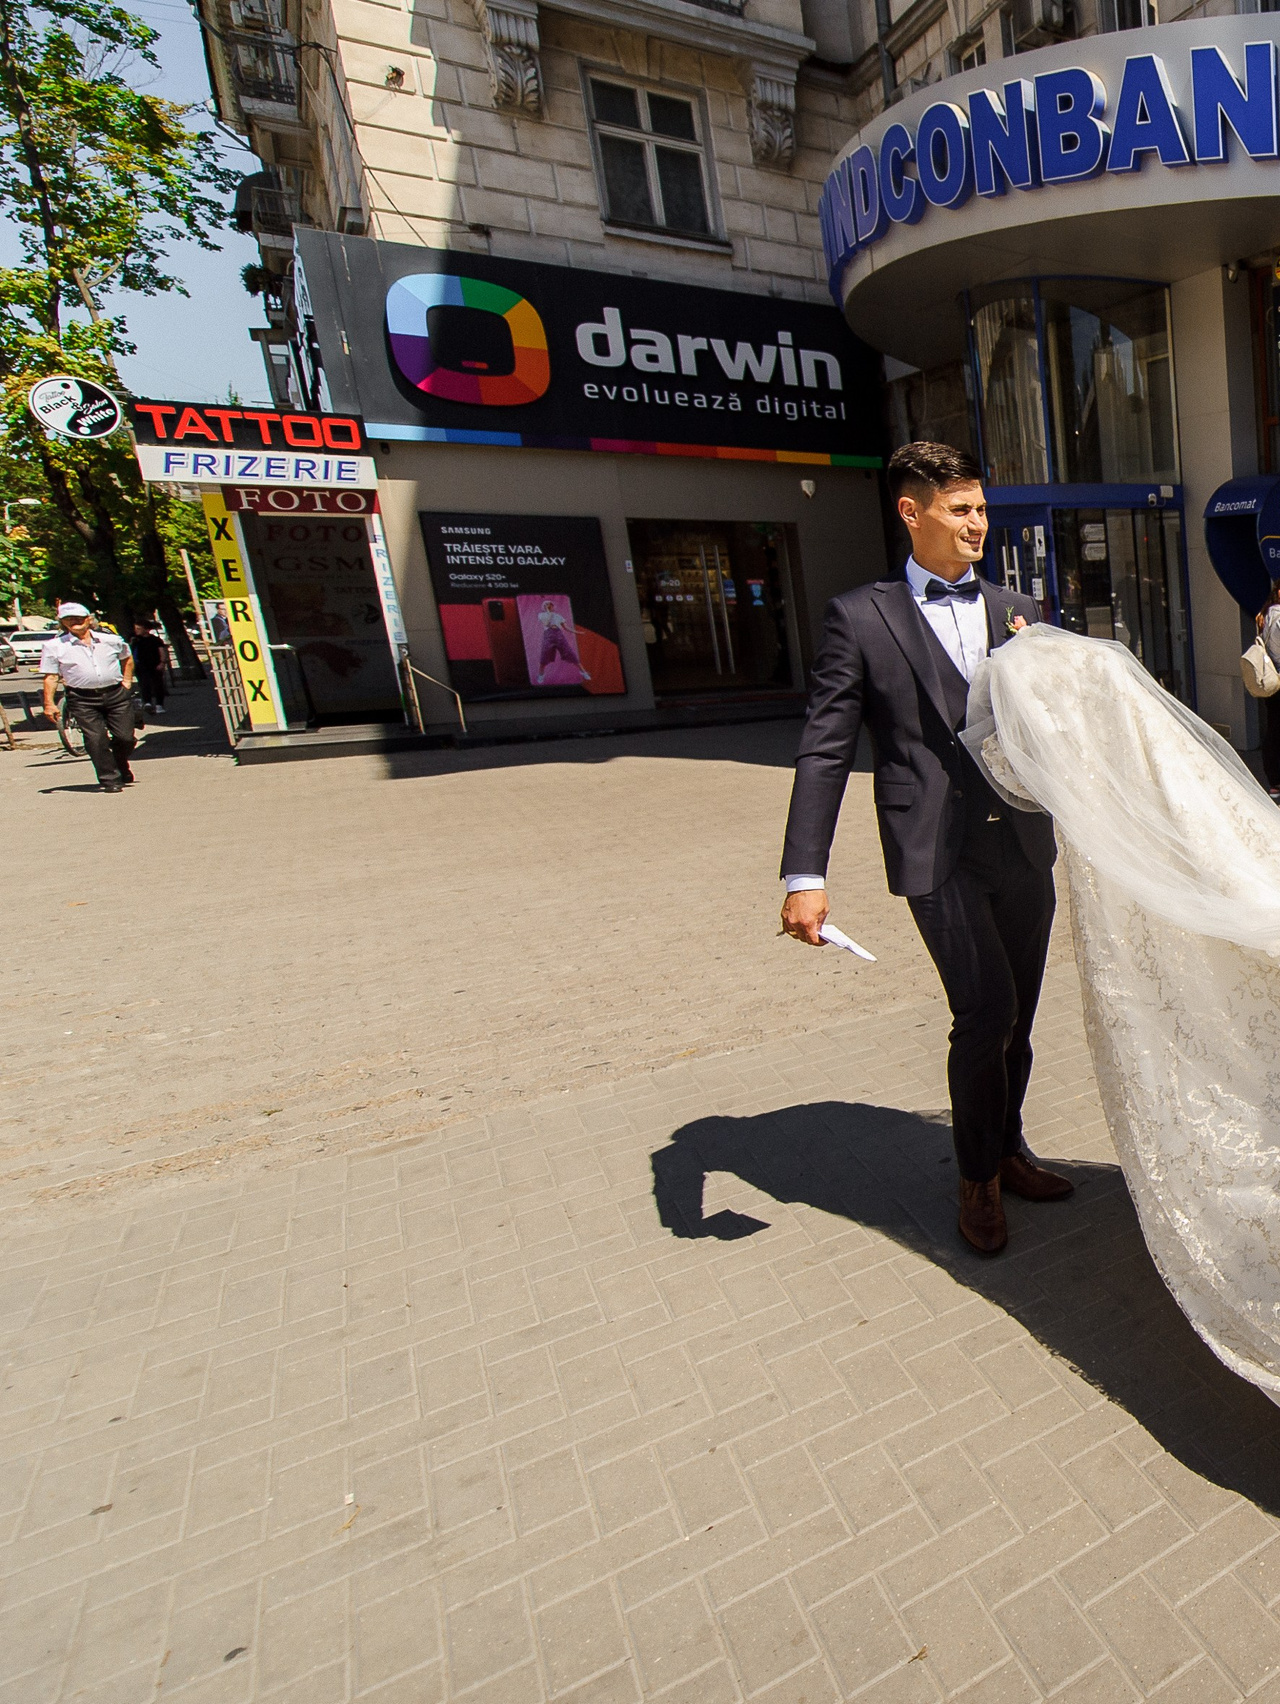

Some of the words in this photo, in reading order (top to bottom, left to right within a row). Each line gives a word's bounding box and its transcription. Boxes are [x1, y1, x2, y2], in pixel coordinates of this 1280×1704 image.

[576, 306, 843, 391] darwin
[39, 395, 77, 415] Black
[583, 382, 742, 412] evoluează
[756, 395, 846, 421] digital
[76, 407, 117, 427] White
[134, 403, 361, 450] TATTOO
[163, 451, 358, 482] FRIZERIE
[235, 488, 368, 513] FOTO
[1214, 498, 1257, 512] Bancomat
[440, 526, 492, 535] SAMSUNG
[446, 555, 494, 565] INTENS
[496, 556, 514, 565] CU
[517, 557, 566, 566] GALAXY
[508, 545, 543, 554] VARA
[373, 534, 405, 642] FRIZERIE
[449, 573, 484, 581] Galaxy
[209, 517, 269, 702] XEROX
